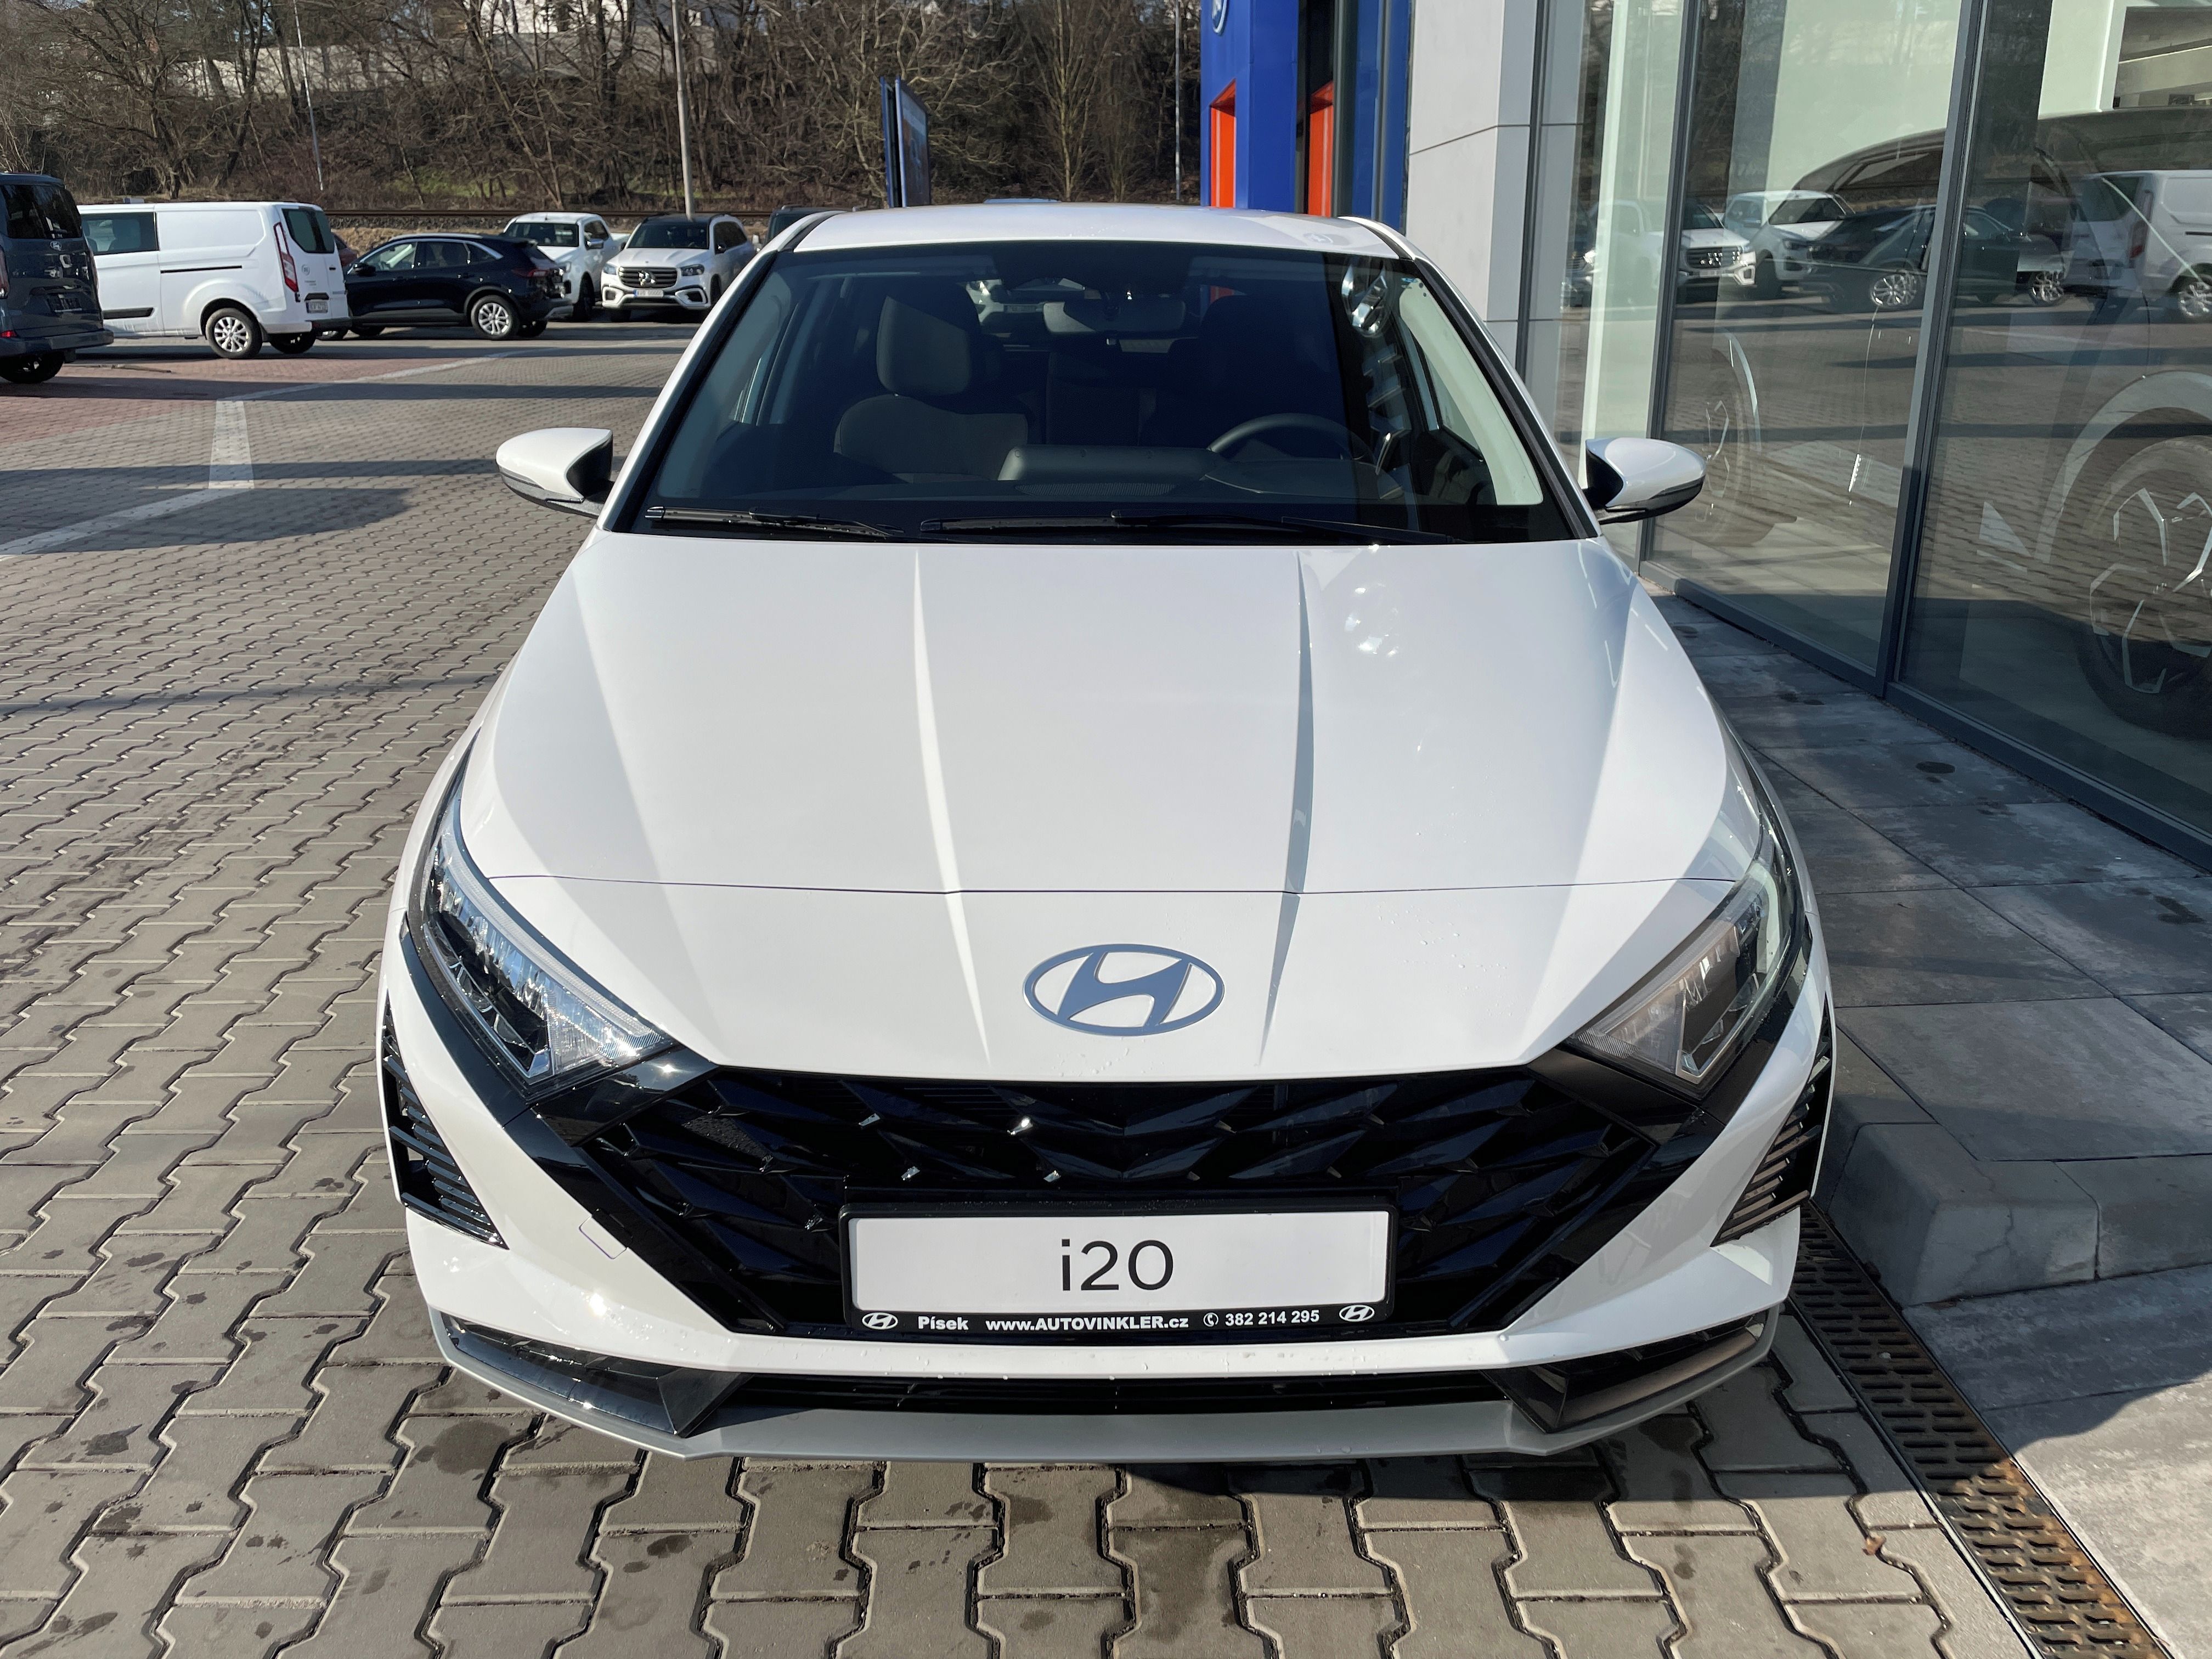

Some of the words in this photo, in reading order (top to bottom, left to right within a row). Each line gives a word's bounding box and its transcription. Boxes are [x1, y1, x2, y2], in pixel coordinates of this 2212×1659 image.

[1062, 1239, 1173, 1291] i20
[918, 1316, 969, 1330] Písek
[985, 1316, 1189, 1331] www.AUTOVINKLER.cz
[1225, 1312, 1254, 1327] 382
[1258, 1311, 1287, 1325] 214
[1291, 1310, 1319, 1323] 295
